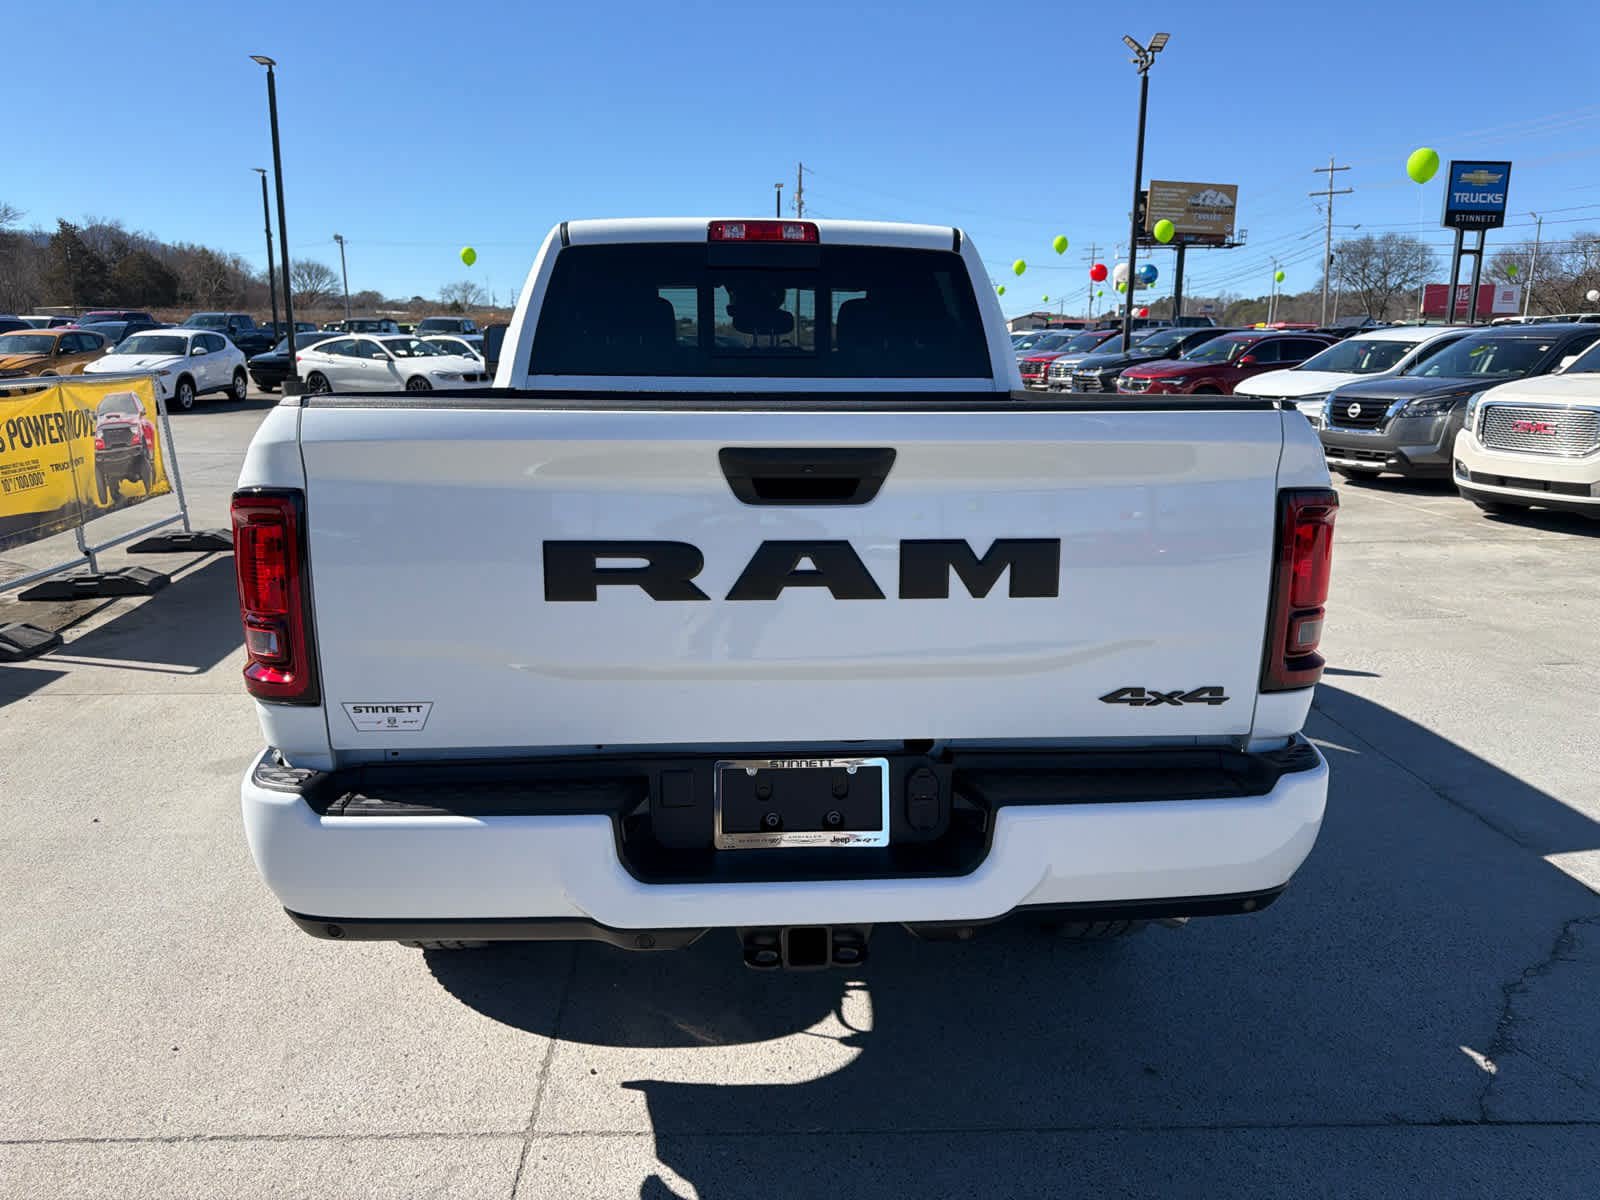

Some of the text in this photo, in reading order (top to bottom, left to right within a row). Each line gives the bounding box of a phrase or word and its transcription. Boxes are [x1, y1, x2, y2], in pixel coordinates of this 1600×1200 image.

[1454, 192, 1504, 204] TRUCKS
[1455, 214, 1497, 223] STINNETT
[1511, 420, 1557, 435] GMC
[542, 537, 1061, 602] RAM
[1098, 686, 1231, 706] 4x4
[352, 704, 423, 714] STINNETT
[768, 759, 835, 769] STINNETT
[830, 835, 850, 845] Jeep
